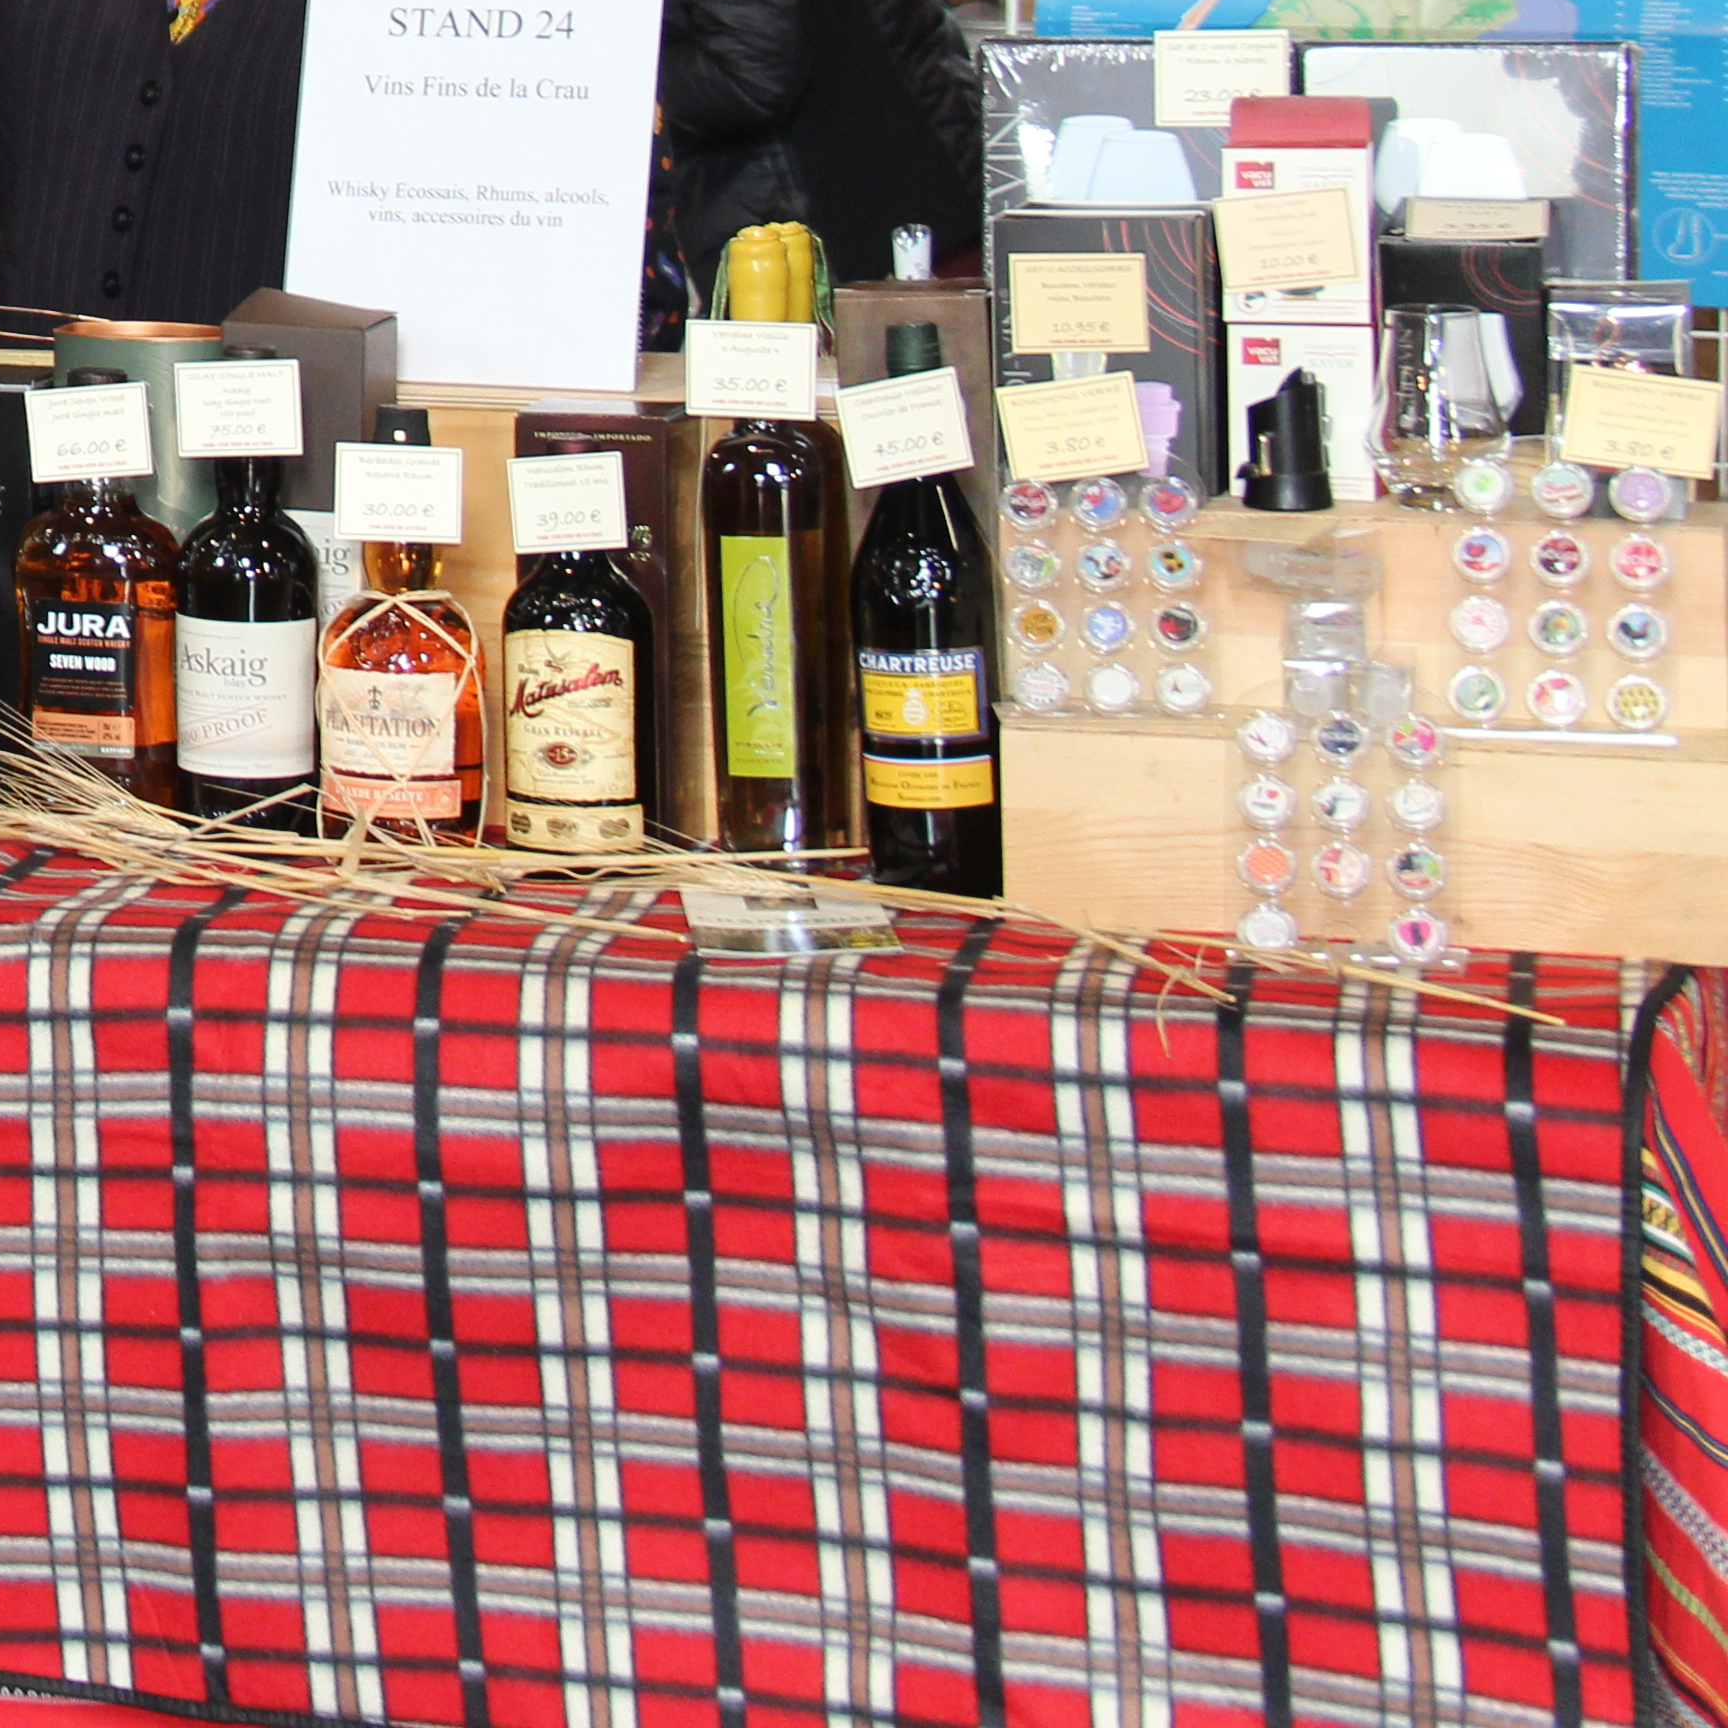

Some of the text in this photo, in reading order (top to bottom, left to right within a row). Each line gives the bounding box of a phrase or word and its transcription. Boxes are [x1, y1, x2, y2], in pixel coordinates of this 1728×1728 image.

[387, 8, 575, 39] STAND 24
[364, 74, 590, 100] Vins Fins de la Crau
[327, 180, 610, 207] Whisky Ecossais, Rhums, alcools,
[367, 207, 563, 228] vins, accessoires du vin
[712, 377, 788, 393] 35.00 €
[209, 423, 267, 439] 75.00 €
[931, 431, 944, 446] €
[56, 439, 127, 457] 66.00 €
[362, 502, 434, 518] 30.00 €
[536, 509, 601, 532] 39.00 €
[36, 611, 131, 638] JURA
[49, 653, 117, 672] SEVEN WOOD
[179, 642, 268, 687] Askaig
[859, 652, 976, 672] CHARTREUSE
[509, 662, 624, 718] Matusalem
[201, 708, 268, 738] PROOF
[555, 747, 569, 761] 15
